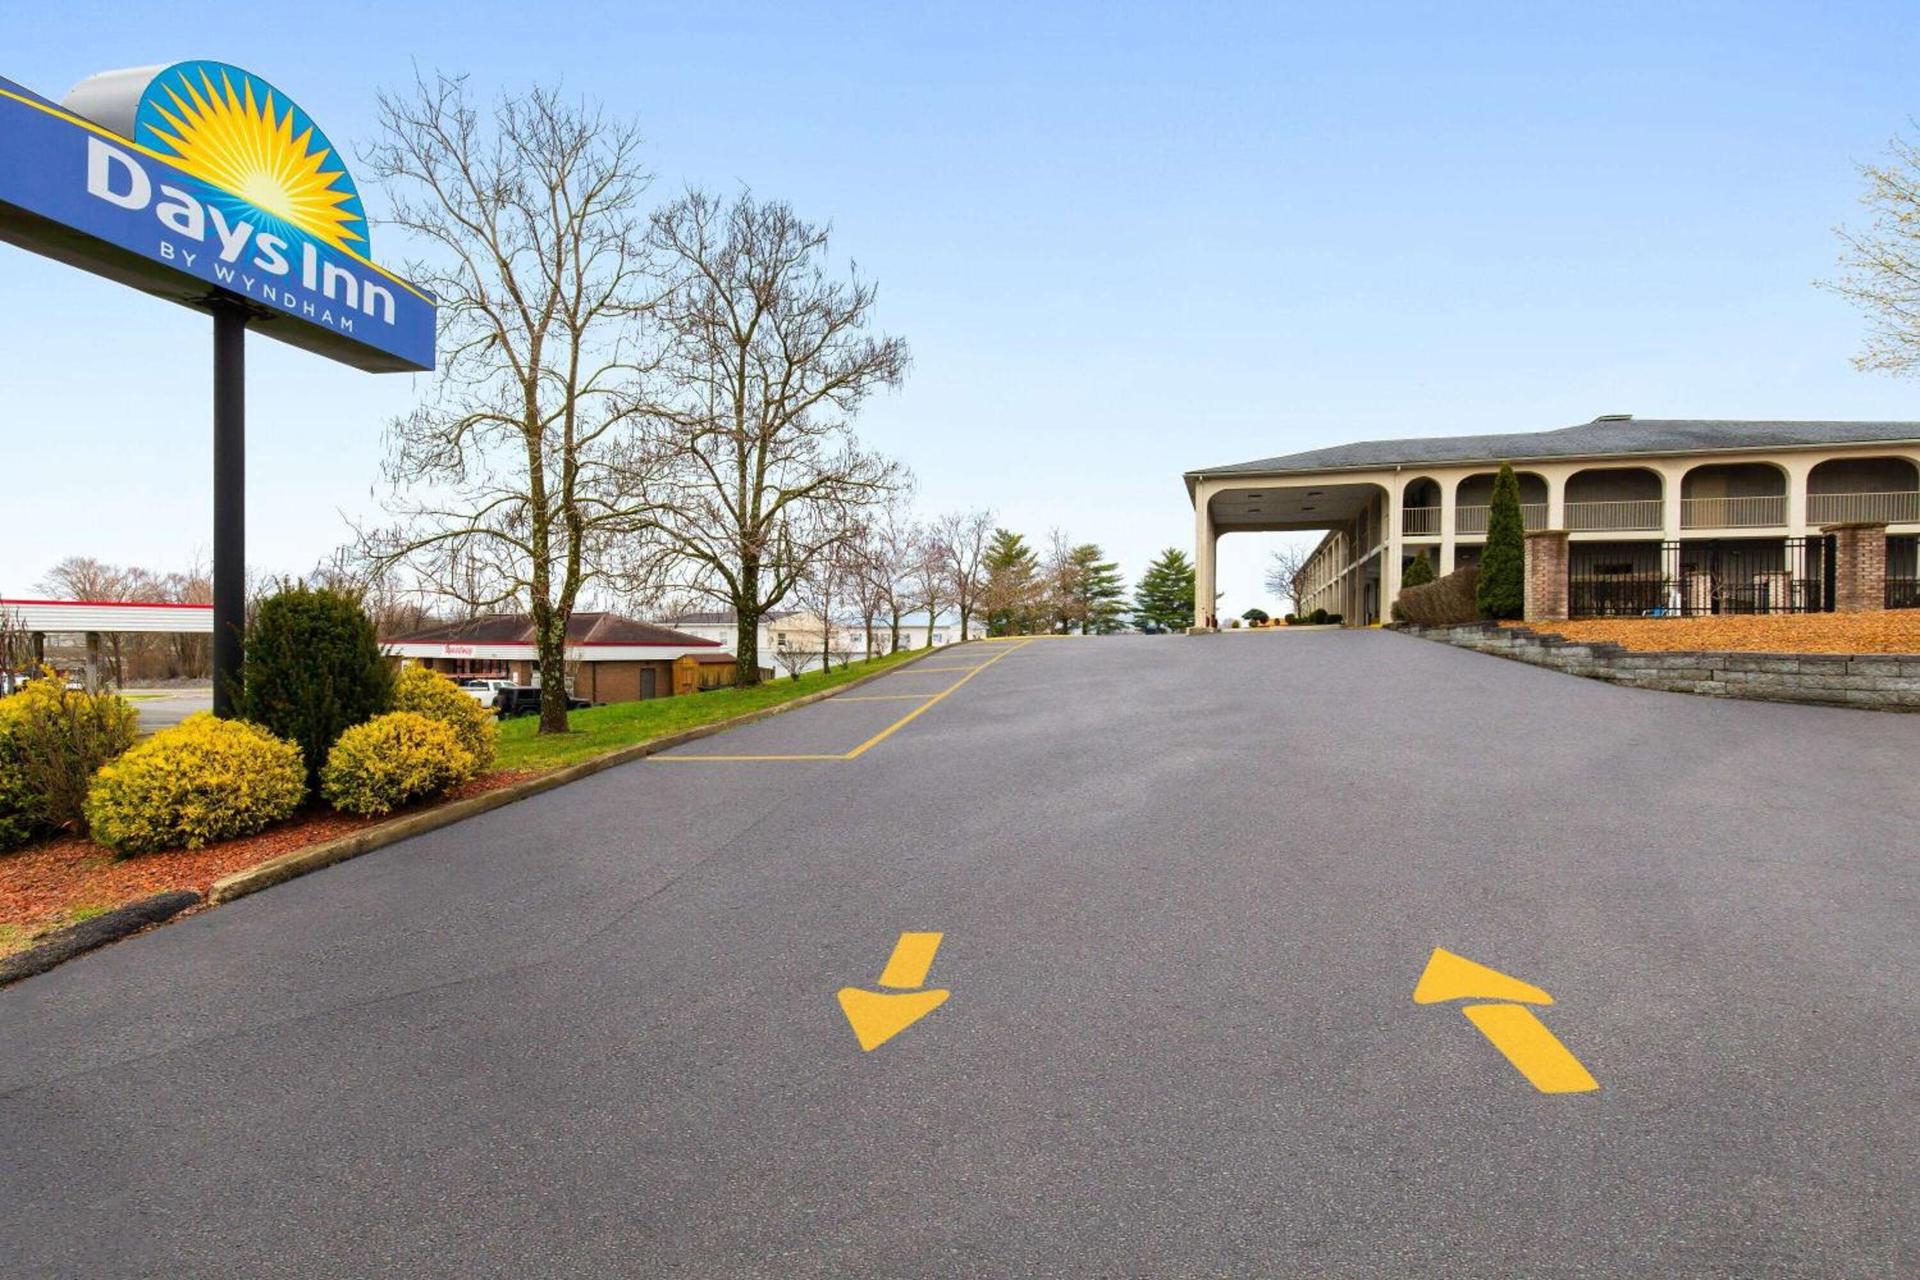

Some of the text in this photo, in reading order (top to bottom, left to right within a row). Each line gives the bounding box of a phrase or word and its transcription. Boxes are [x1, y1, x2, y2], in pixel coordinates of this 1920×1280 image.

[88, 136, 395, 325] Days Inn
[160, 241, 354, 332] BY WYNDHAM
